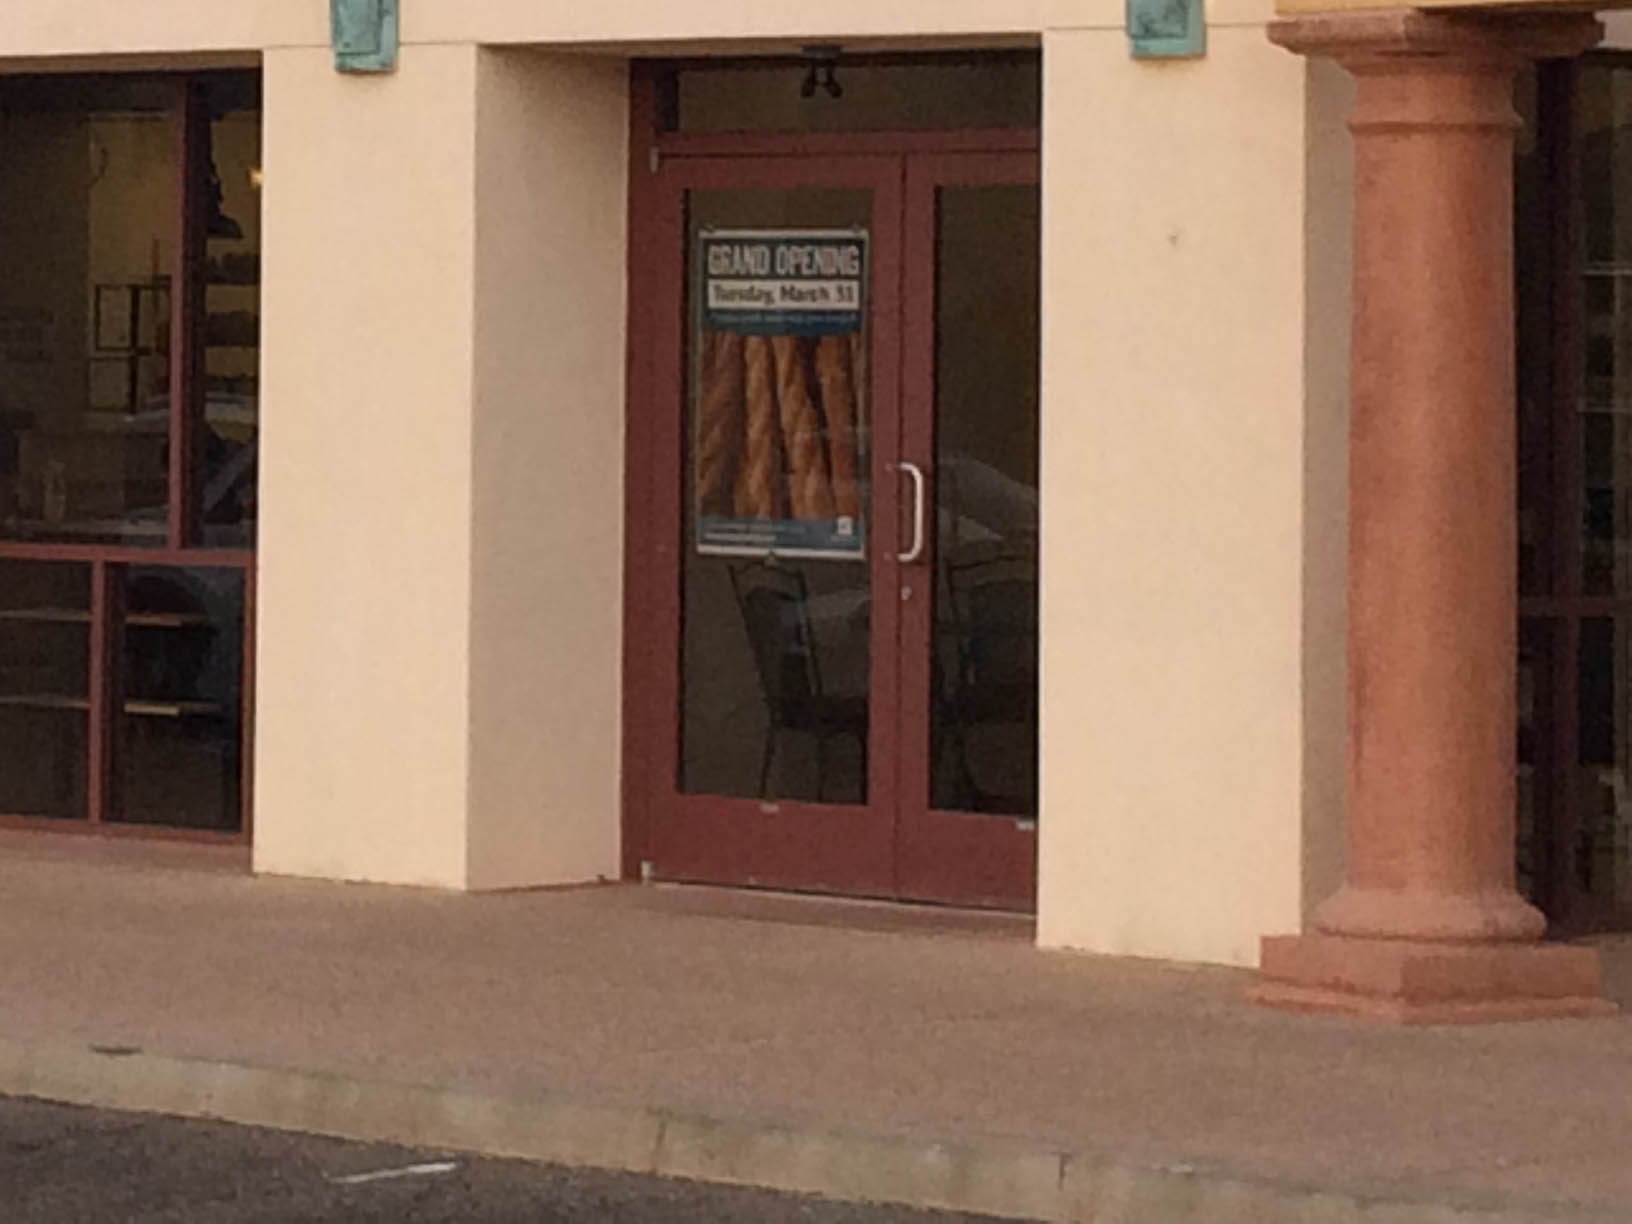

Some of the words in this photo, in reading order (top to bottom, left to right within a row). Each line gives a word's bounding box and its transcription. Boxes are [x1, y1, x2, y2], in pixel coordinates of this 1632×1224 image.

[708, 245, 768, 275] GRAND
[775, 245, 859, 275] OPENING
[779, 284, 830, 302] March
